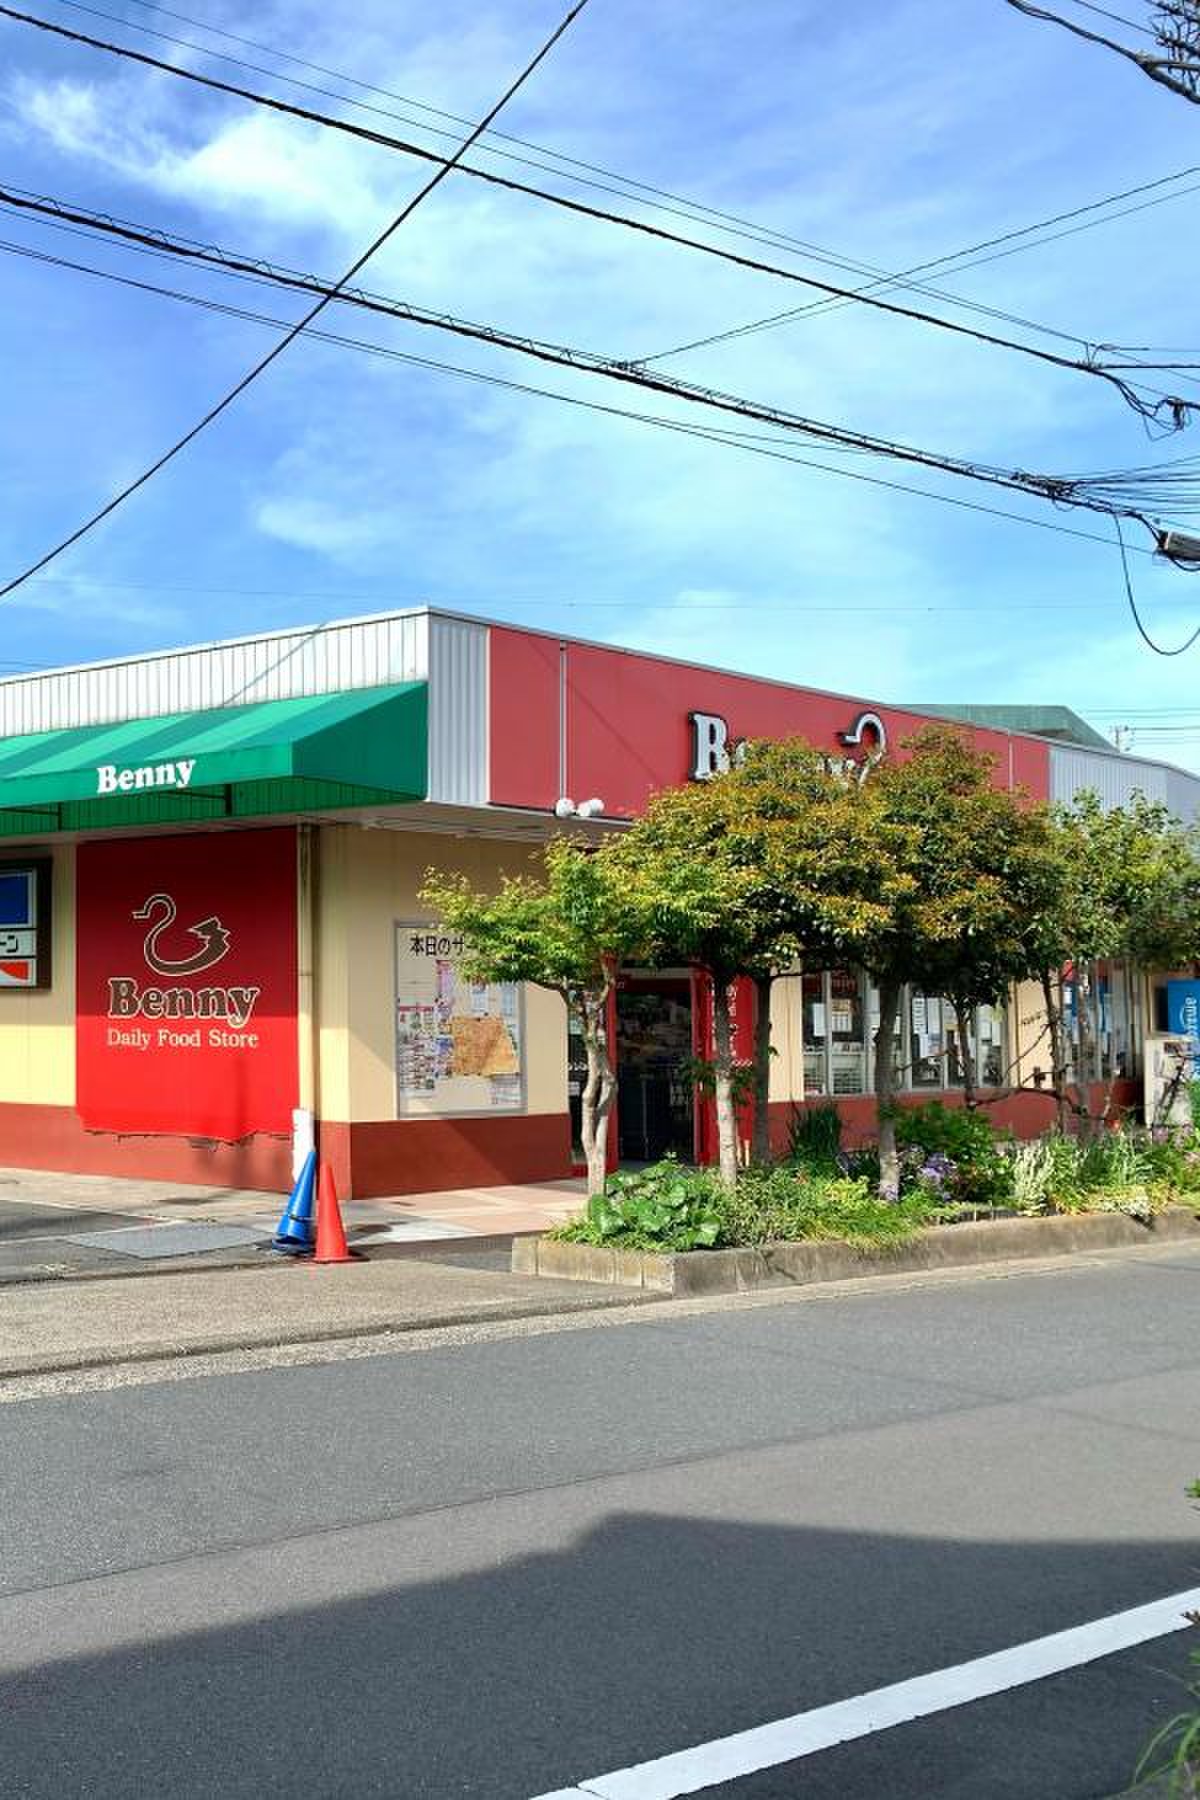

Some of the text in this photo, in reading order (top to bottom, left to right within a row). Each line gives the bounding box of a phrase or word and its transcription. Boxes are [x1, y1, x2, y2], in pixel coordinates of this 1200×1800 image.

[96, 759, 197, 794] Benny
[108, 977, 260, 1028] Benny
[107, 1028, 259, 1050] Daily Food Store
